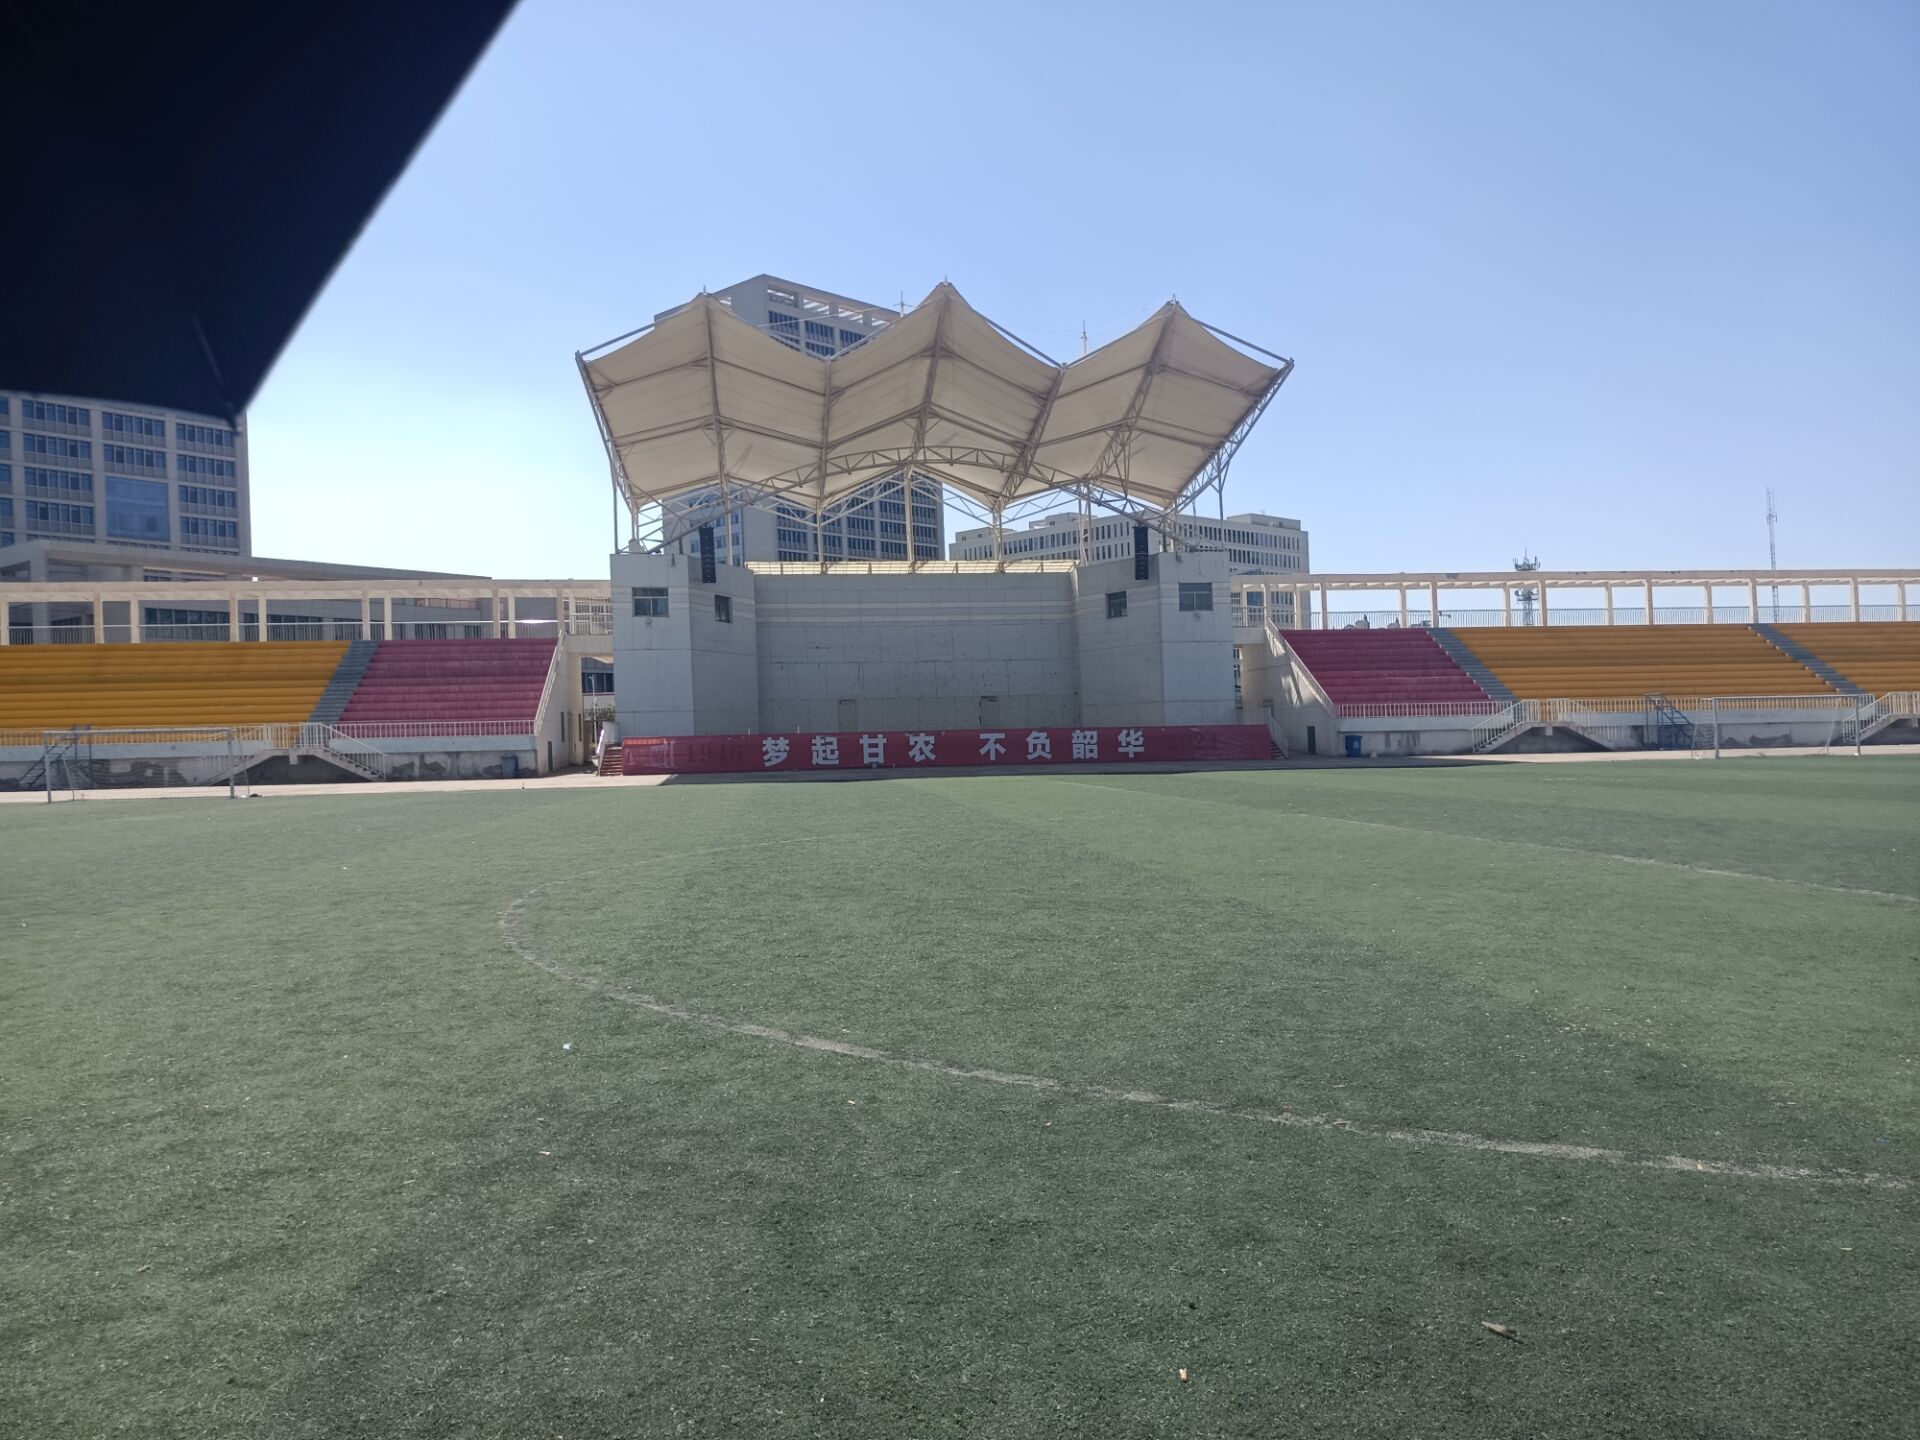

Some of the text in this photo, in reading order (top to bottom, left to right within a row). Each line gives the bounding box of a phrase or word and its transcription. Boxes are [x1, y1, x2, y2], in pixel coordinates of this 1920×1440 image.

[762, 728, 1145, 767] 梦起甘农 不负韶华
